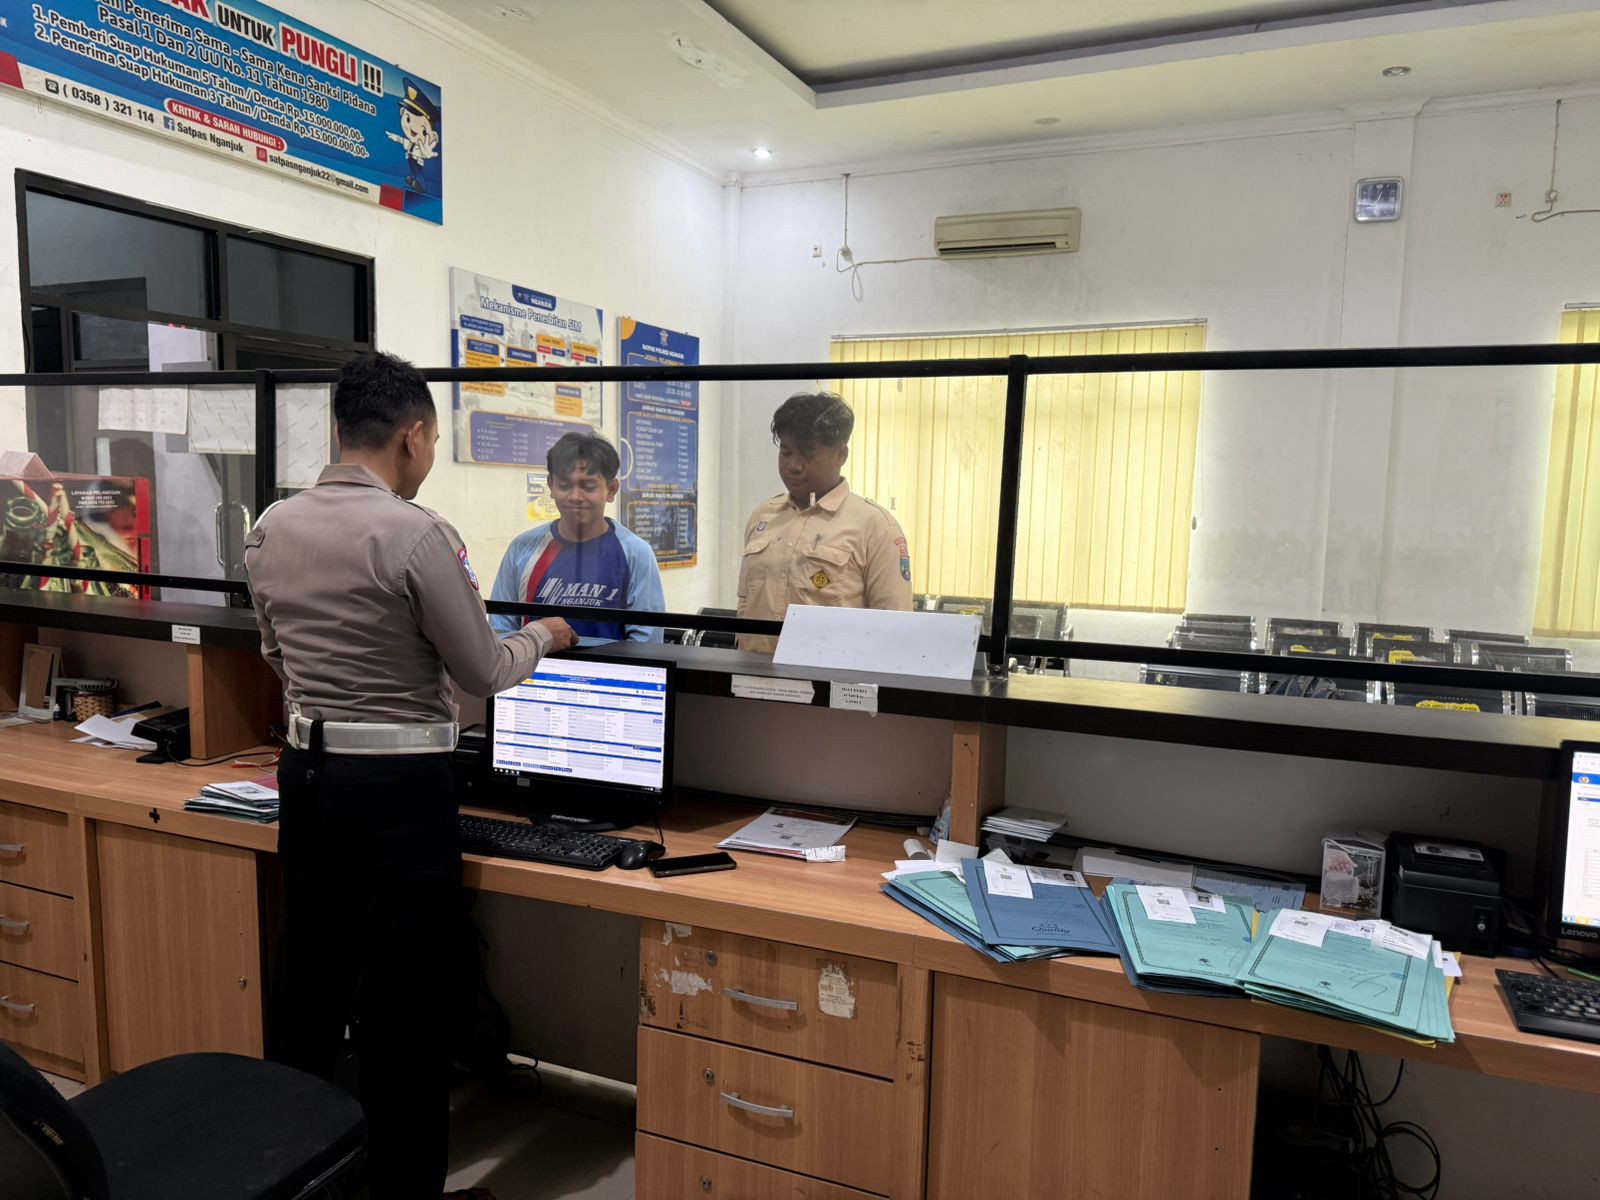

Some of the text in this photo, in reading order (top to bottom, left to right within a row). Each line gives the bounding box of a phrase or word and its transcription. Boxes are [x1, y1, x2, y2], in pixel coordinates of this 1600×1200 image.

[34, 6, 47, 21] 1.
[50, 12, 106, 42] Pemberi
[109, 35, 140, 58] Suap
[143, 49, 199, 79] Hukuman
[202, 72, 209, 83] 5
[211, 76, 245, 96] Tahun
[246, 89, 252, 99] /
[254, 92, 285, 112] Denda
[288, 105, 302, 119] Rp.
[99, 7, 328, 109] Pasal 1 Dan 2 UU No. 11 Tahun 1980
[125, 0, 191, 38] Penerima
[195, 29, 231, 54] Sama
[241, 48, 274, 72] Sama
[277, 63, 305, 85] Kena
[308, 76, 341, 99] Sanksi
[343, 92, 376, 115] Pidana
[217, 4, 274, 47] UNTUK
[281, 25, 357, 83] PUNGLI
[363, 63, 382, 94] !!!
[35, 25, 48, 40] 2.
[52, 31, 115, 65] Penerima
[118, 56, 149, 79] Suap
[152, 69, 207, 99] Hukuman
[209, 89, 216, 101] 3
[218, 94, 252, 114] Tahun
[253, 106, 259, 118] /
[261, 109, 291, 130] Denda
[293, 122, 308, 137] Rp.
[63, 84, 155, 123] ( 0358 ) 321 114
[171, 104, 201, 121] KRITIK
[203, 114, 211, 123] &
[212, 116, 241, 134] SARAN
[242, 125, 276, 148] HUBUNGI
[177, 122, 244, 153] Satpas Nganjuk
[269, 154, 369, 194] satpasnganjuk22@gmail.com
[480, 296, 527, 319] Mekanisme
[528, 308, 567, 329] Penerbitan
[568, 319, 582, 333] SIM
[561, 597, 603, 606] NGANJUK
[562, 583, 619, 601] MAN 1
[1561, 927, 1598, 939] Lenovo
